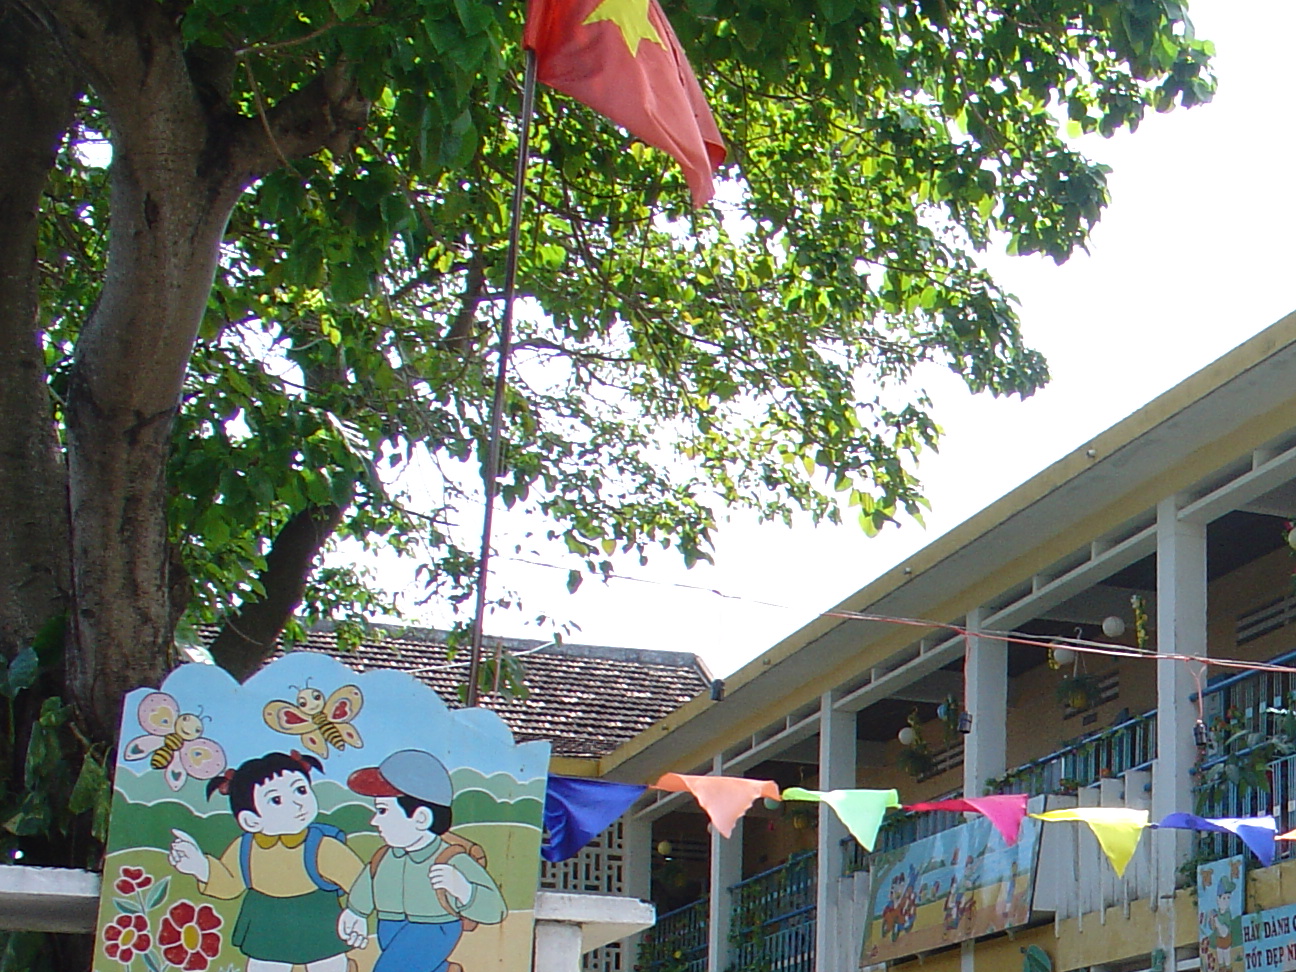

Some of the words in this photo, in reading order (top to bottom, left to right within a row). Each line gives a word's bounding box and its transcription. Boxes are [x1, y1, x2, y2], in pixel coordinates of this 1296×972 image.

[1264, 916, 1290, 938] DÀNH
[1246, 946, 1262, 969] TỐT
[1266, 946, 1284, 968] ĐẸP
